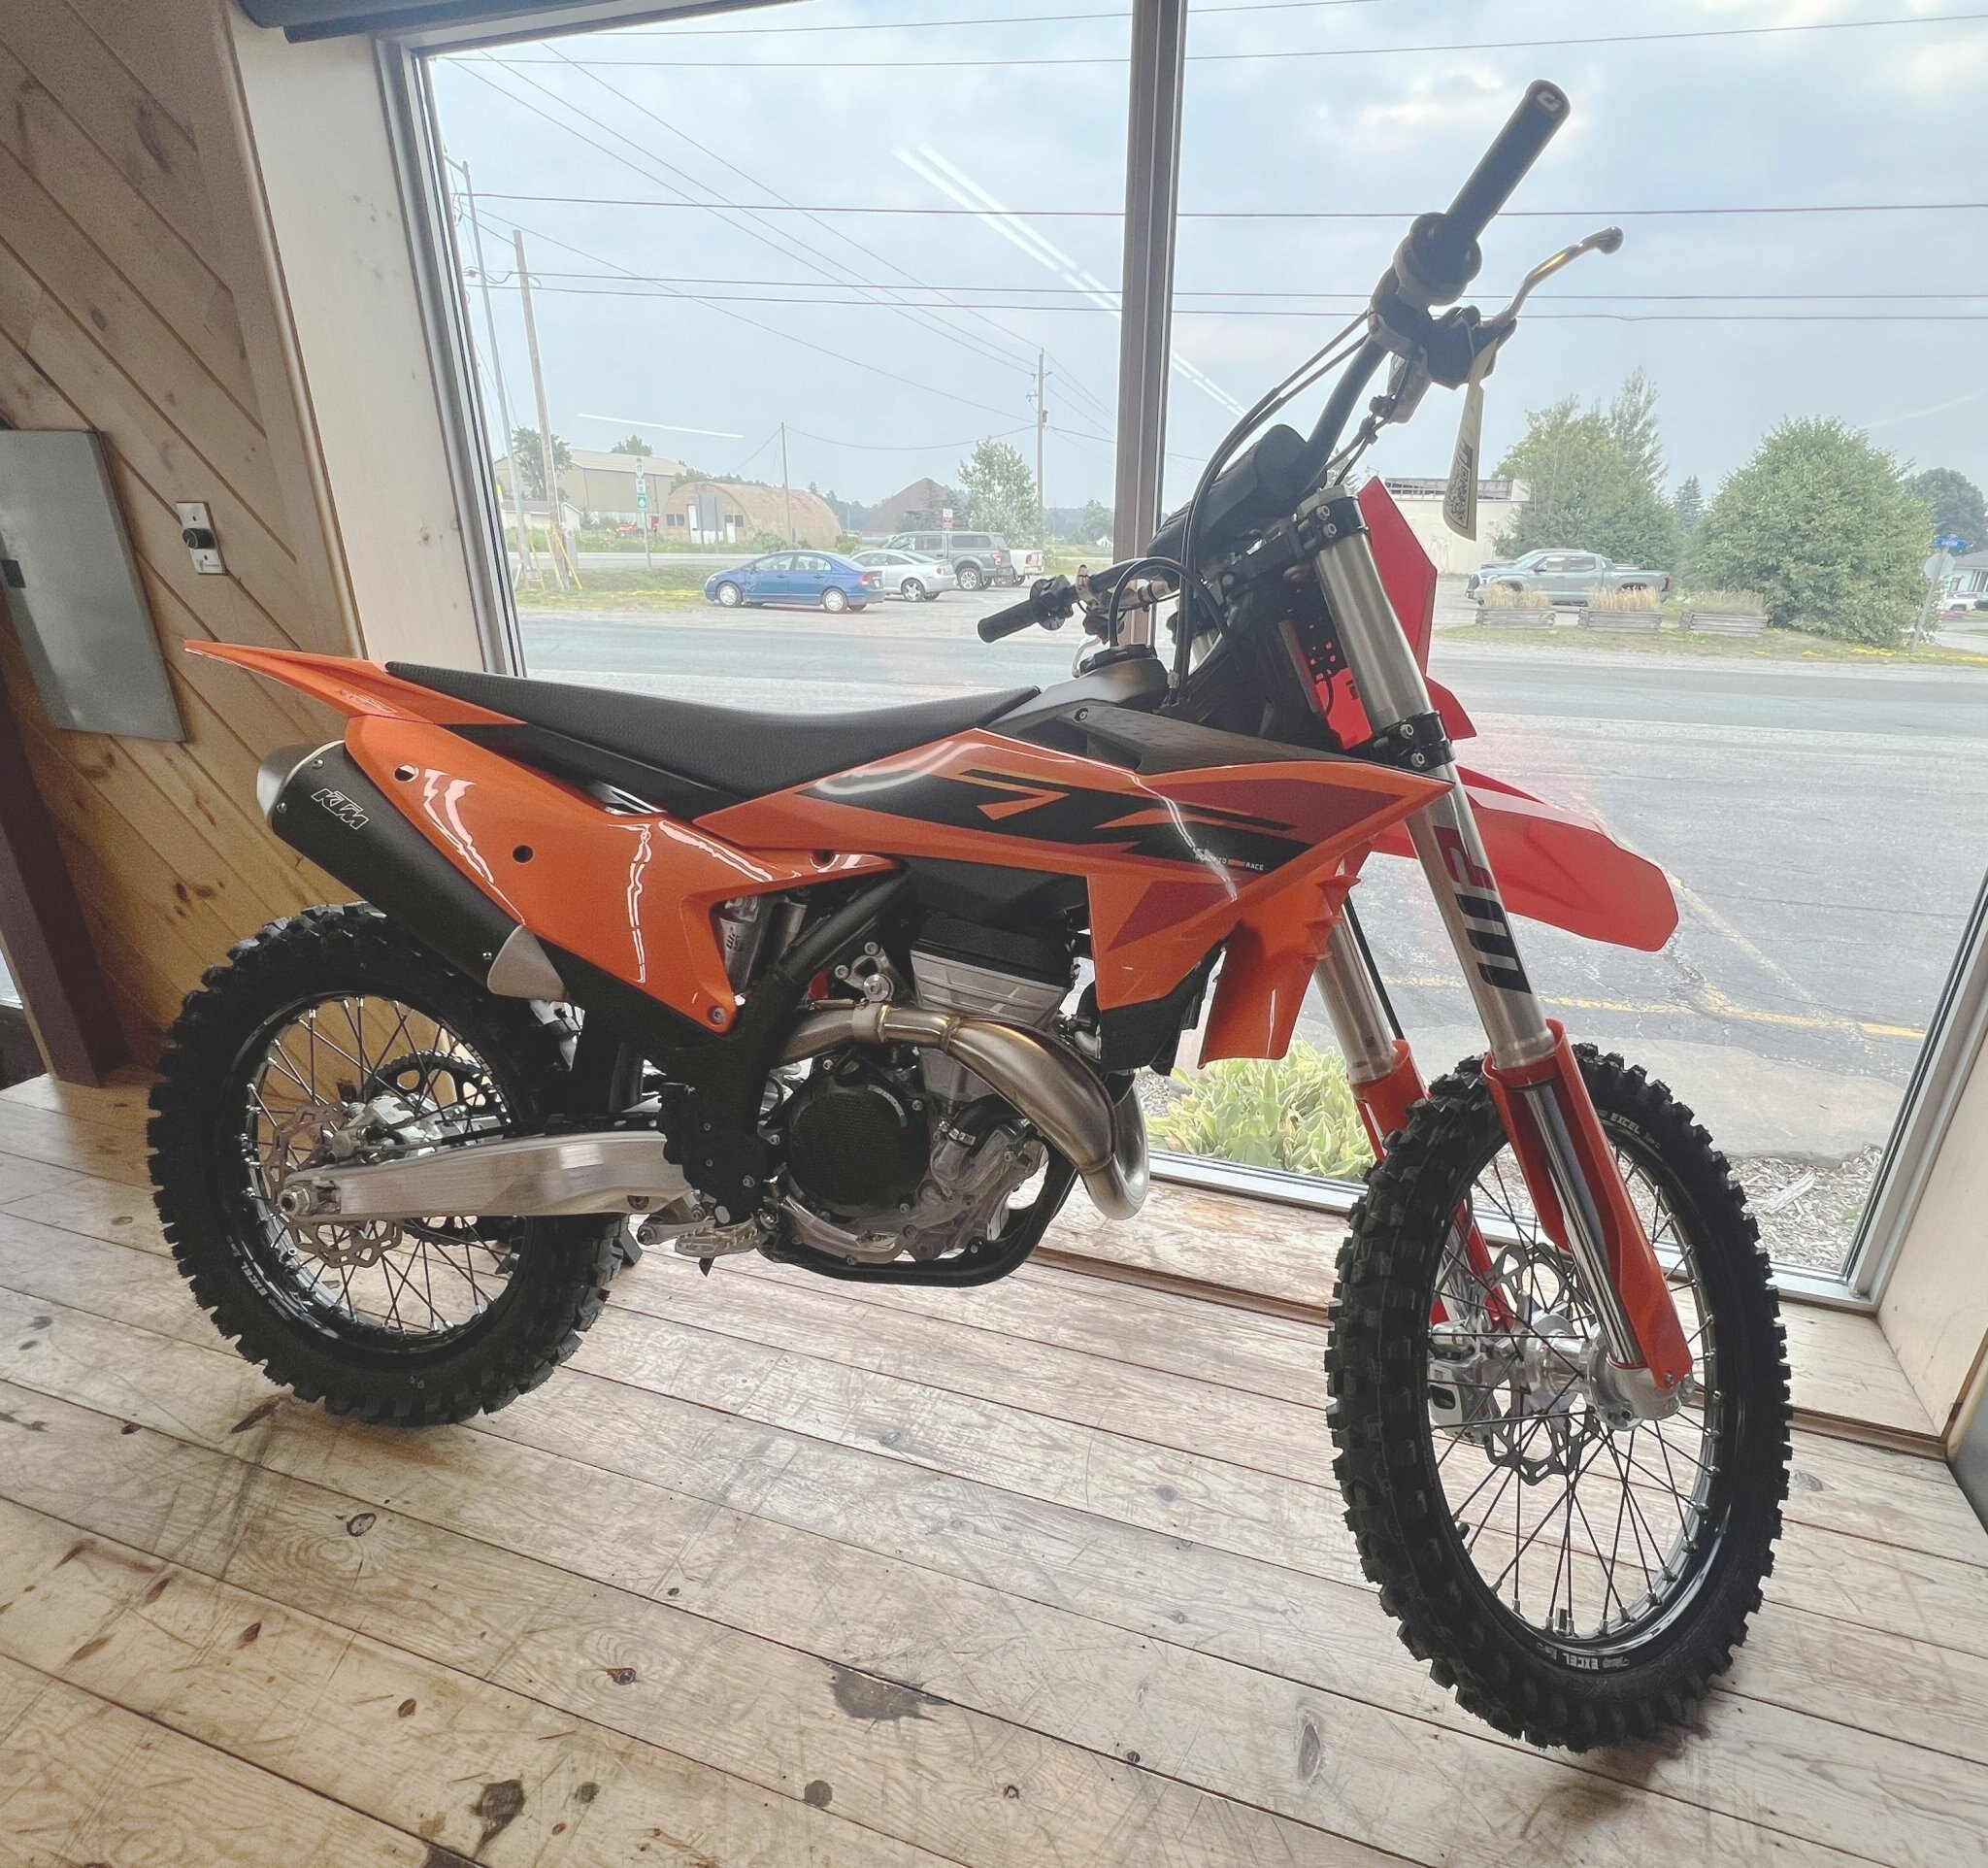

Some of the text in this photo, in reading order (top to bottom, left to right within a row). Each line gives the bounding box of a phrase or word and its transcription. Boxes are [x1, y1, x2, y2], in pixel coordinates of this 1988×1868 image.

[310, 787, 370, 830] KTM
[1245, 861, 1265, 871] RACE
[1609, 1113, 1640, 1134] EXCEL
[241, 1260, 269, 1296] EXCEL
[1562, 1652, 1600, 1670] EXCEL
